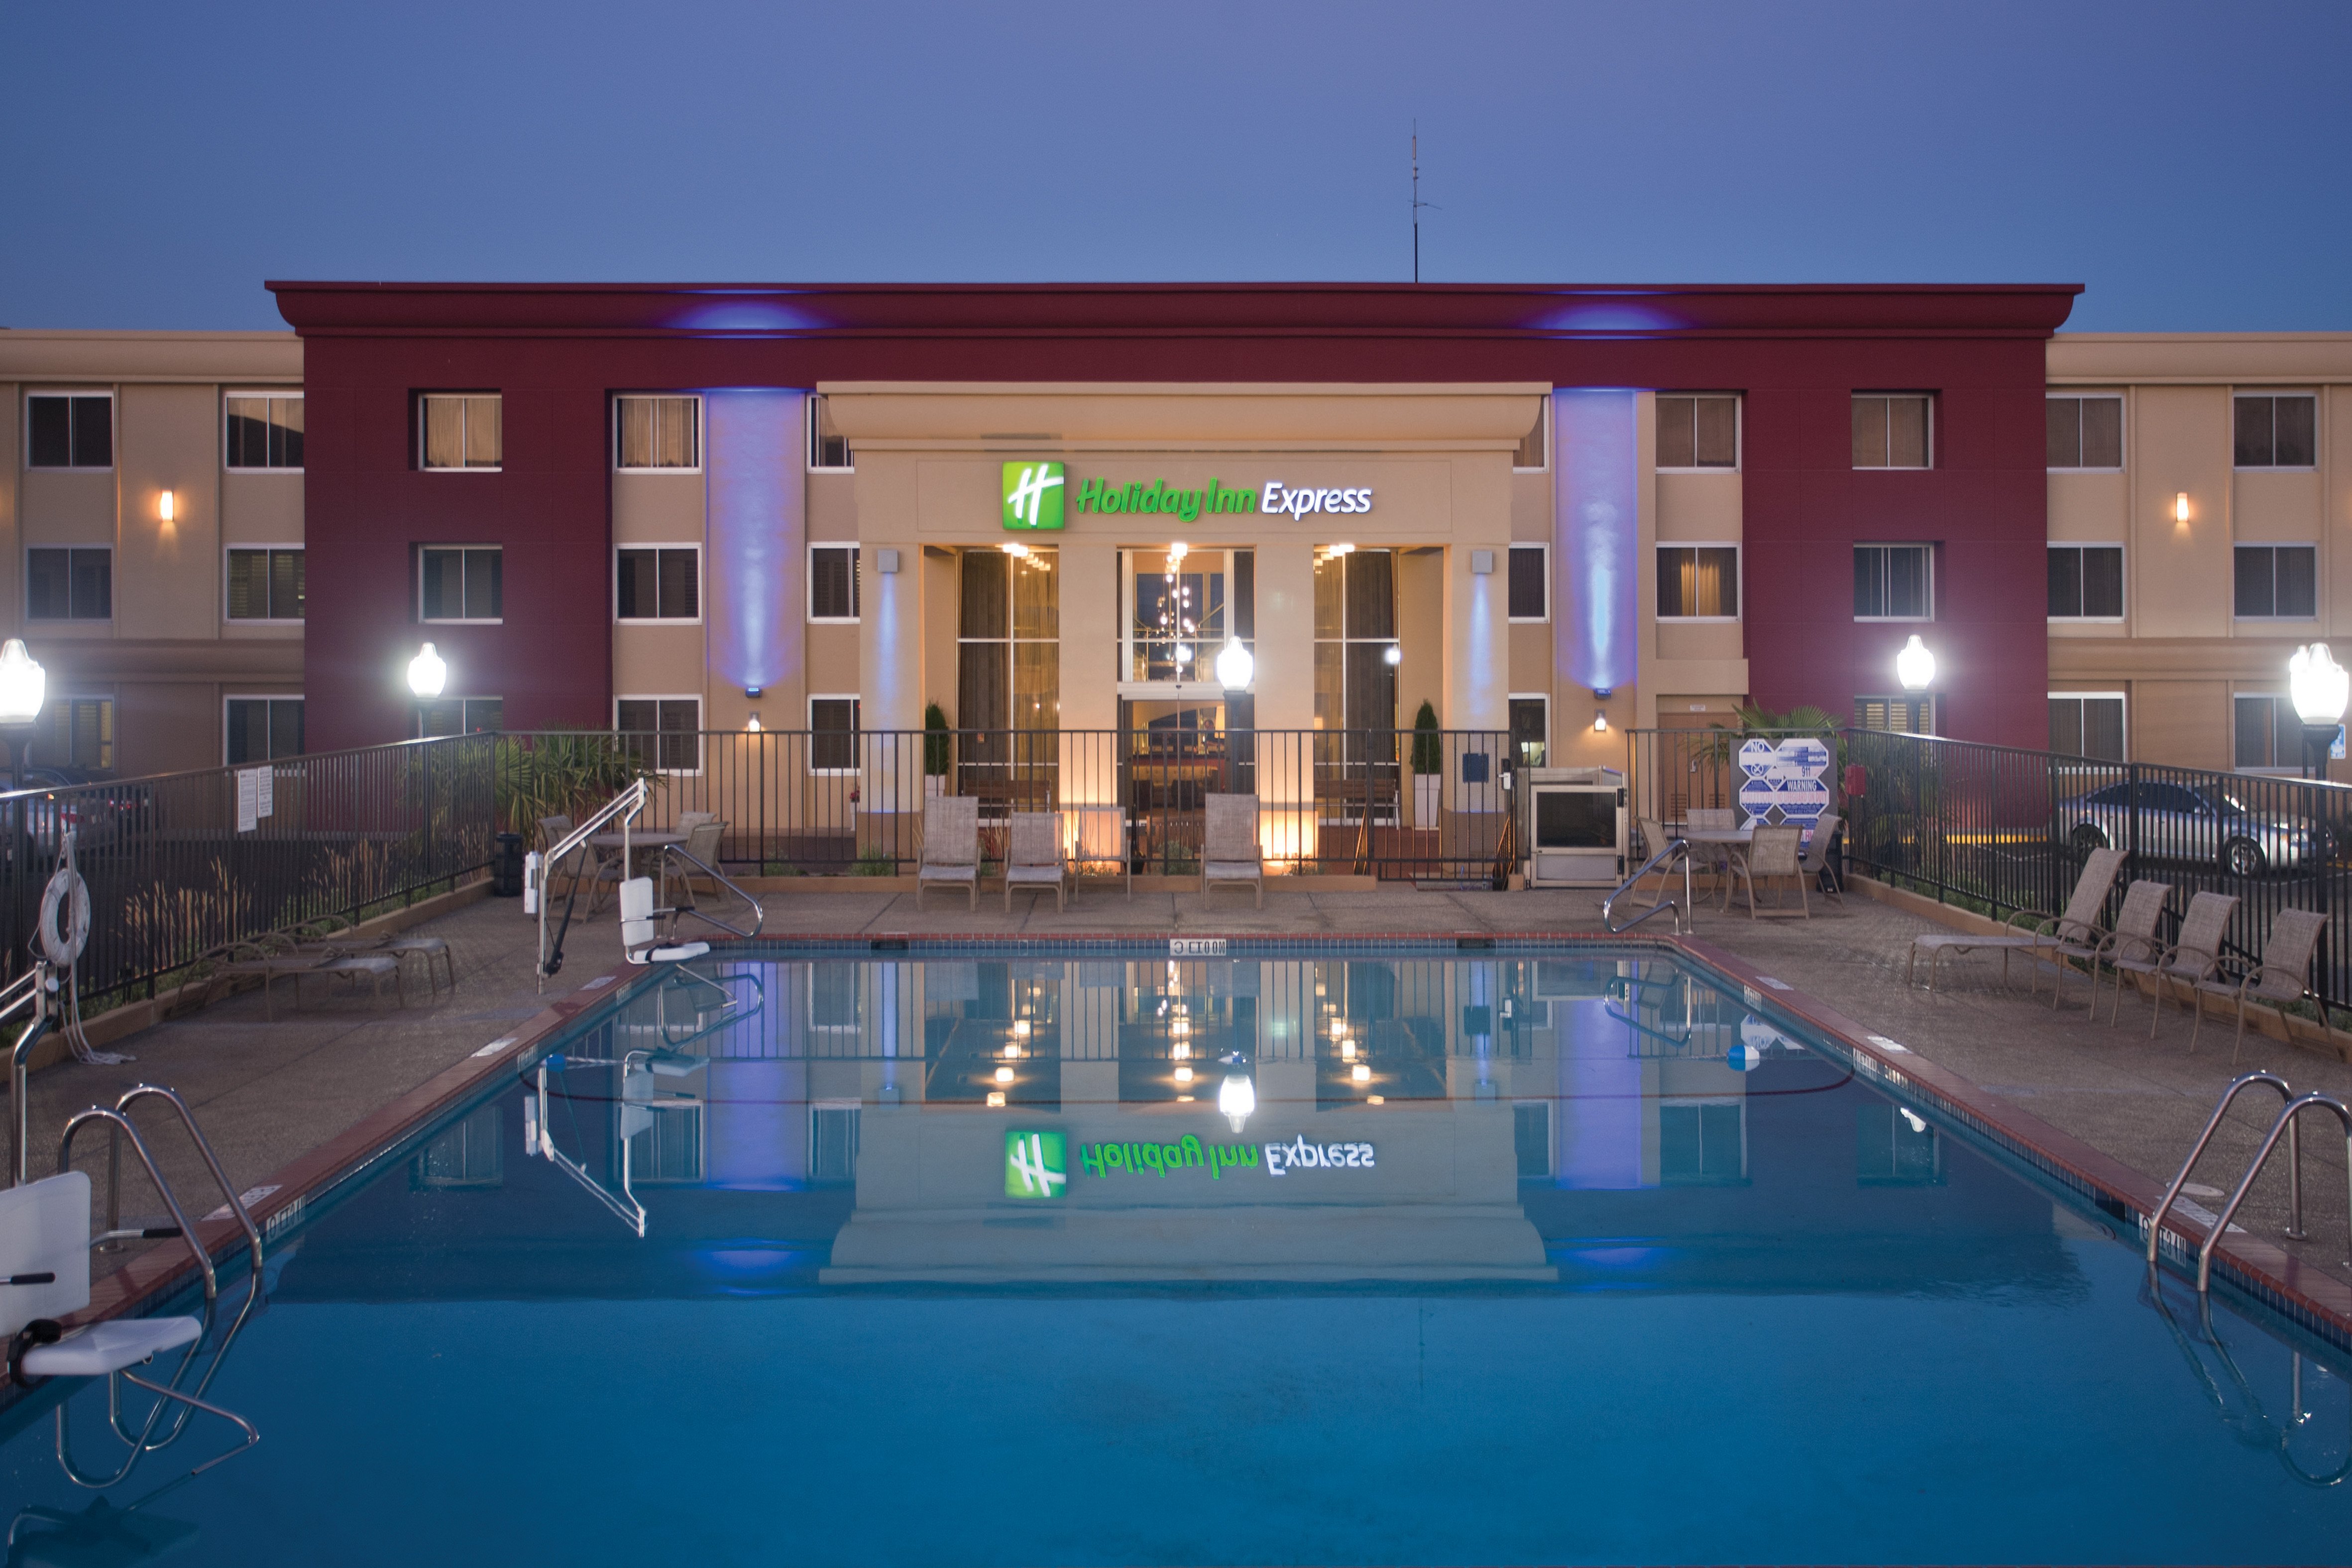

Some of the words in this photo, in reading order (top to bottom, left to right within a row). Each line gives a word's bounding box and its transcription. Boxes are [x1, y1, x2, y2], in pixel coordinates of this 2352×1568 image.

[1077, 477, 1203, 522] Holiday
[1206, 477, 1255, 514] Inn
[1261, 482, 1372, 521] Express
[1751, 742, 1765, 752] NO
[1801, 766, 1810, 777] 911
[1787, 780, 1817, 791] WARNING
[1815, 792, 1826, 803] DUTY
